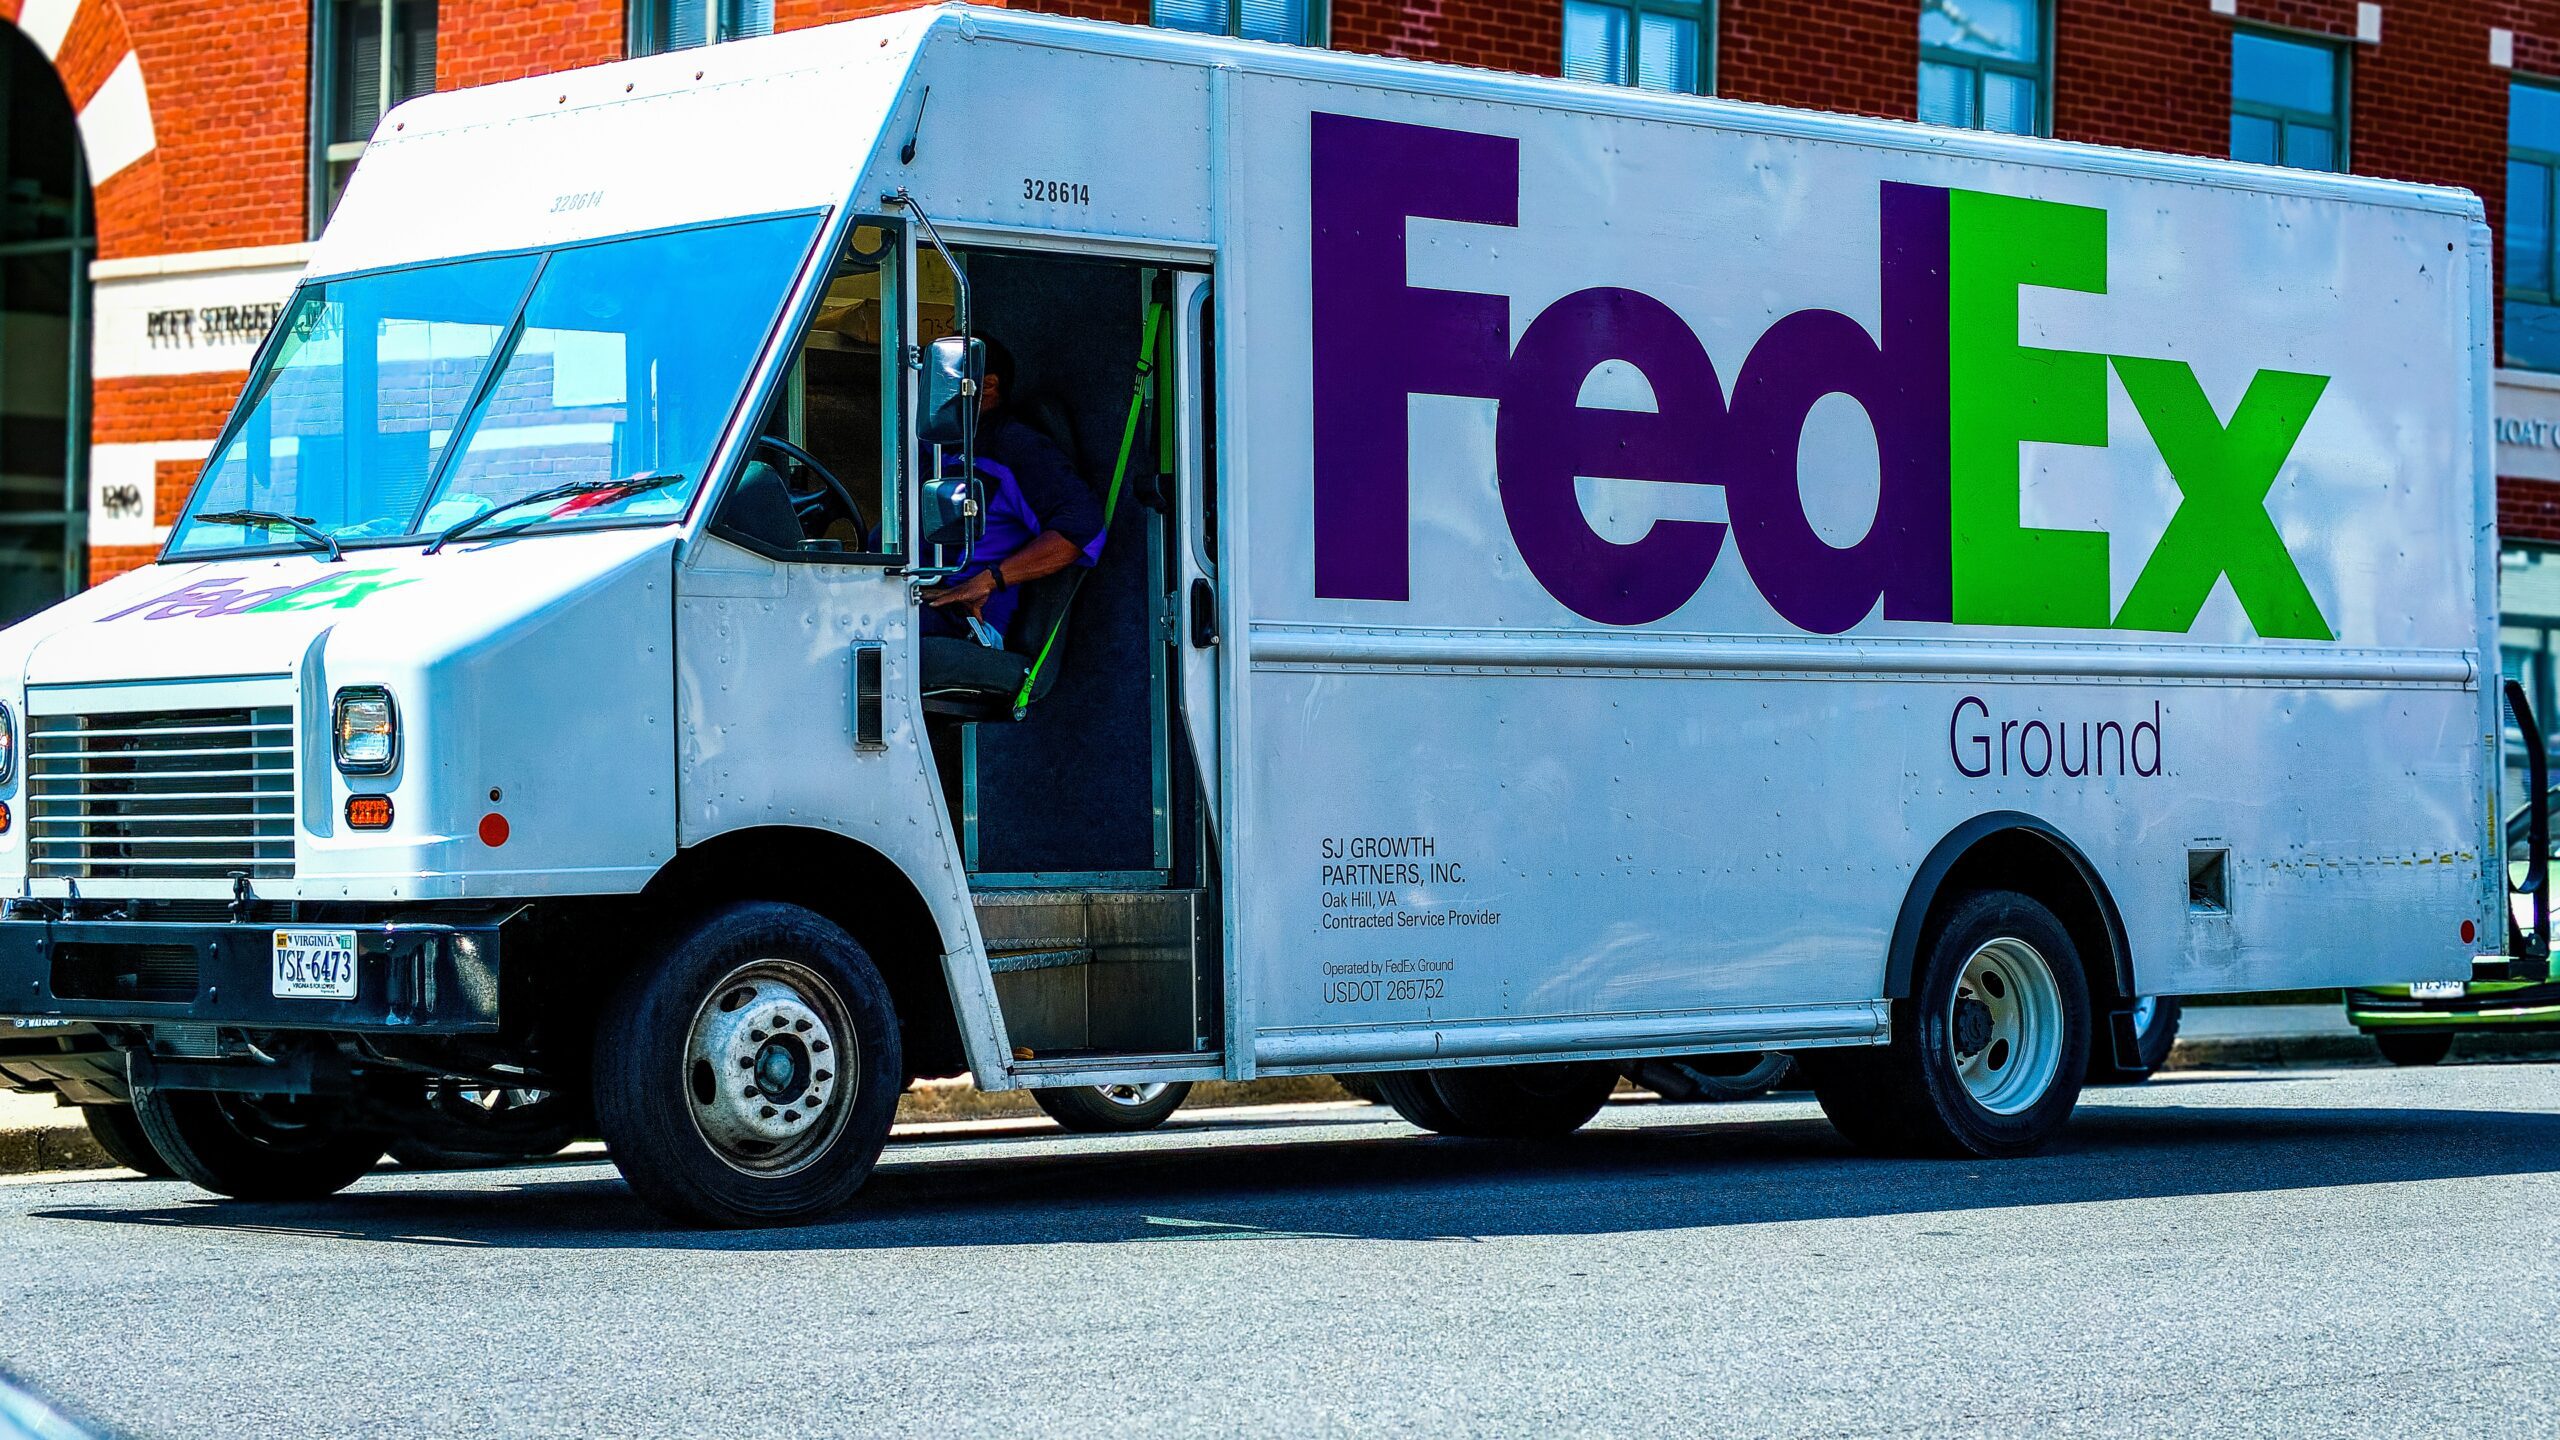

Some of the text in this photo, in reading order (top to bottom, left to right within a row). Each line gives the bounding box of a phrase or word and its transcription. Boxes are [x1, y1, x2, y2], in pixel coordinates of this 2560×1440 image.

[550, 190, 604, 213] 328614
[1023, 178, 1089, 205] 328614
[147, 309, 194, 337] PITT
[1311, 111, 2336, 641] FedEx
[93, 568, 424, 622] FedEx
[1950, 695, 2162, 778] Ground
[1322, 837, 1435, 859] SJ GROWTH
[1322, 862, 1467, 887] PARTNERS, INC.
[1322, 891, 1397, 909] Oak Hill, VA
[1322, 910, 1501, 929] Contracted Service Provider
[294, 935, 334, 947] VIRGINIA
[277, 950, 351, 983] VSK-6473
[1322, 958, 1454, 977] Operated by FedEx Ground
[1323, 978, 1444, 1004] USDOT 265752
